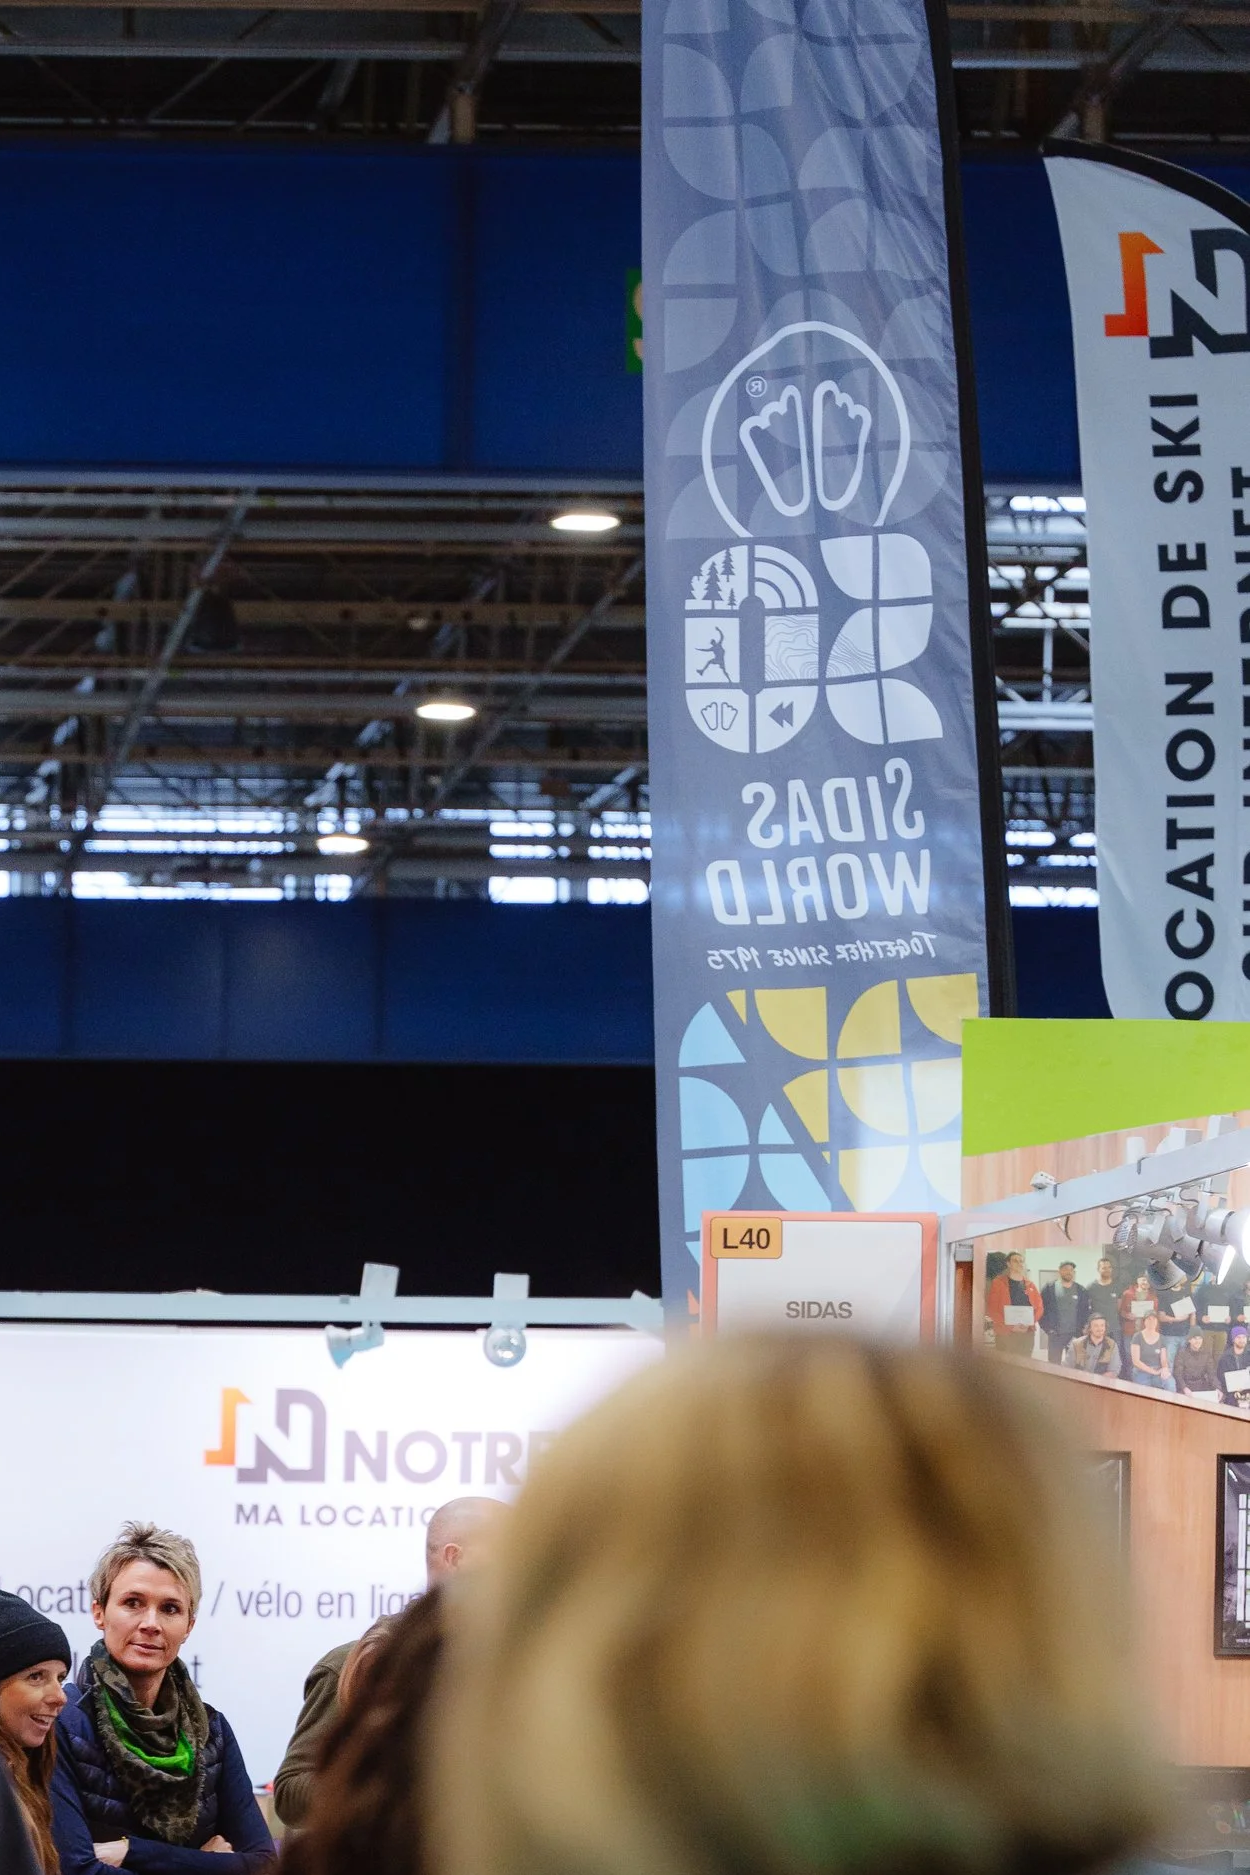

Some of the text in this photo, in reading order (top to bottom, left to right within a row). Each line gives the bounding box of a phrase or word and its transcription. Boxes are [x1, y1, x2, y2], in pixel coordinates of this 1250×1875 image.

[1149, 393, 1217, 1021] OCATION DE SKI
[722, 1227, 771, 1250] L40
[785, 1300, 853, 1319] SIDAS
[235, 1503, 284, 1526] MA
[236, 1580, 303, 1619] vélo
[316, 1589, 356, 1619] en
